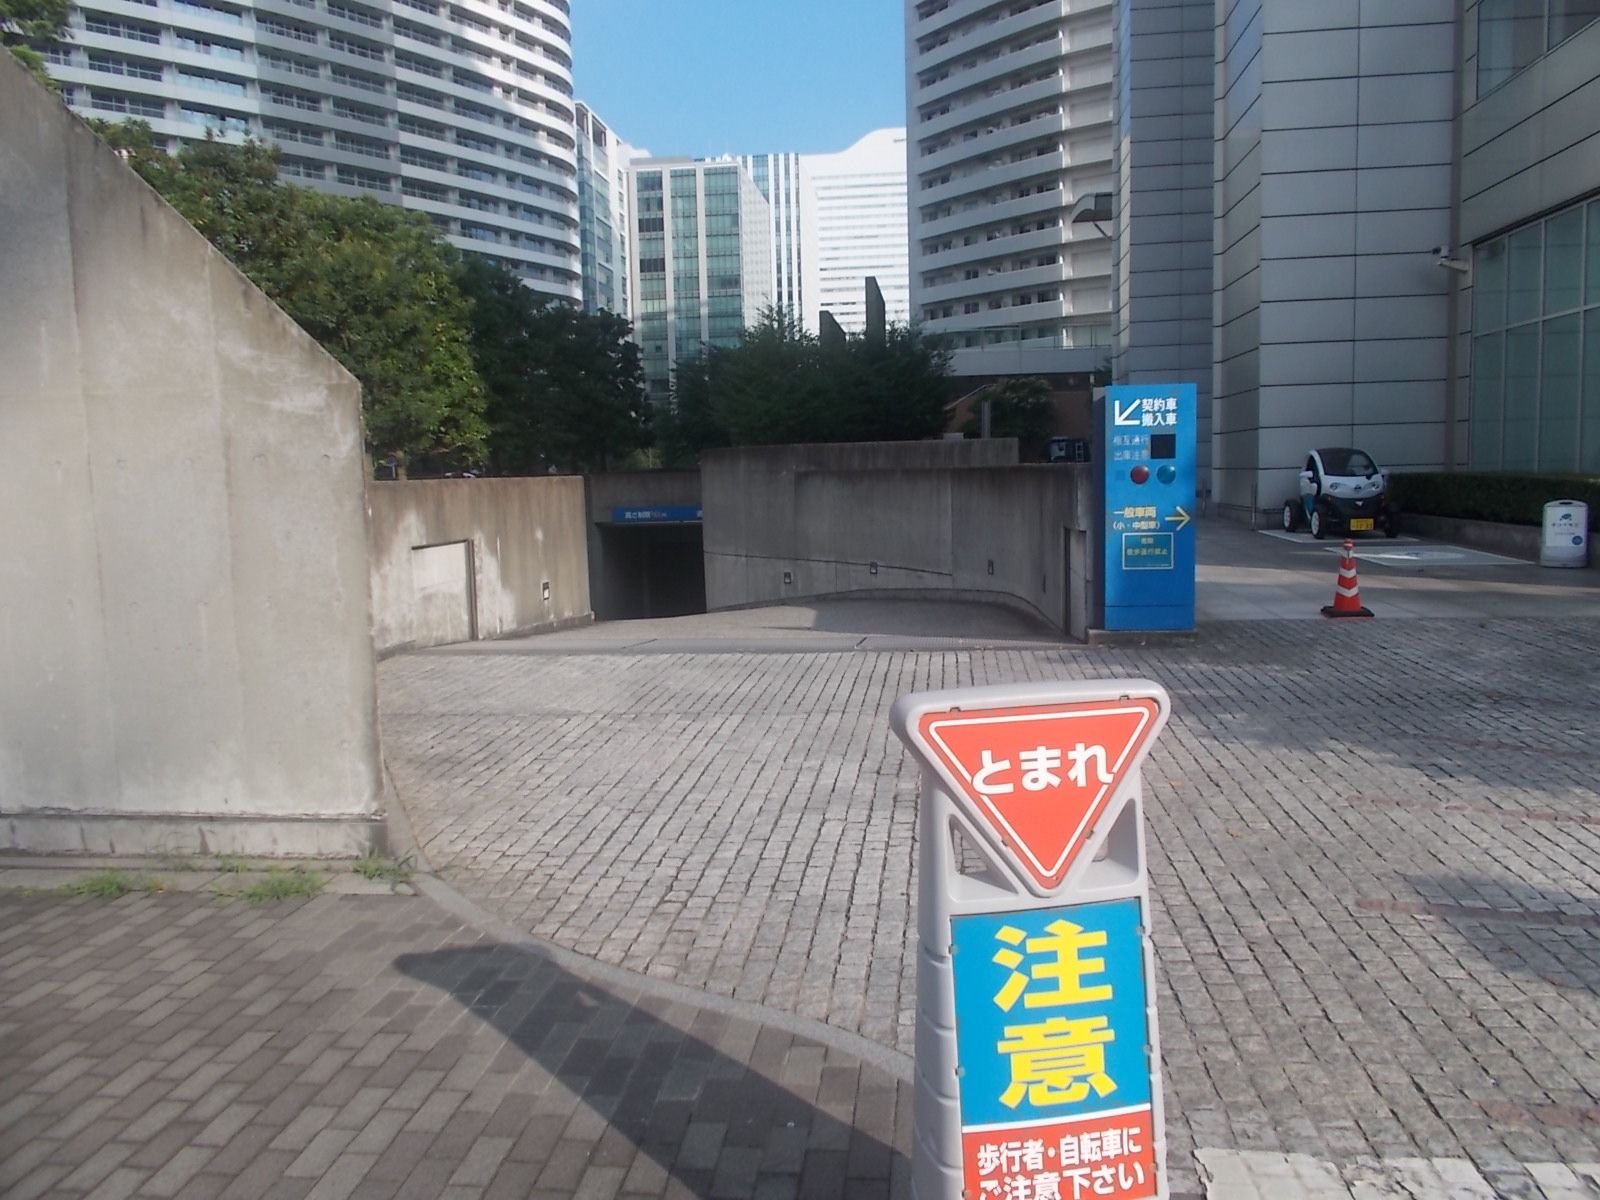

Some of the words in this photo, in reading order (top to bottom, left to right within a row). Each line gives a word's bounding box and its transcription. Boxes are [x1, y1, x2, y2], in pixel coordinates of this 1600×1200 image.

[1141, 397, 1178, 412] 契約車
[972, 742, 1115, 796] とまれ
[991, 918, 1119, 1110] 注意
[976, 1126, 1143, 1176] 歩行者・自転車に
[977, 1160, 1145, 1200] ご注意下さい
